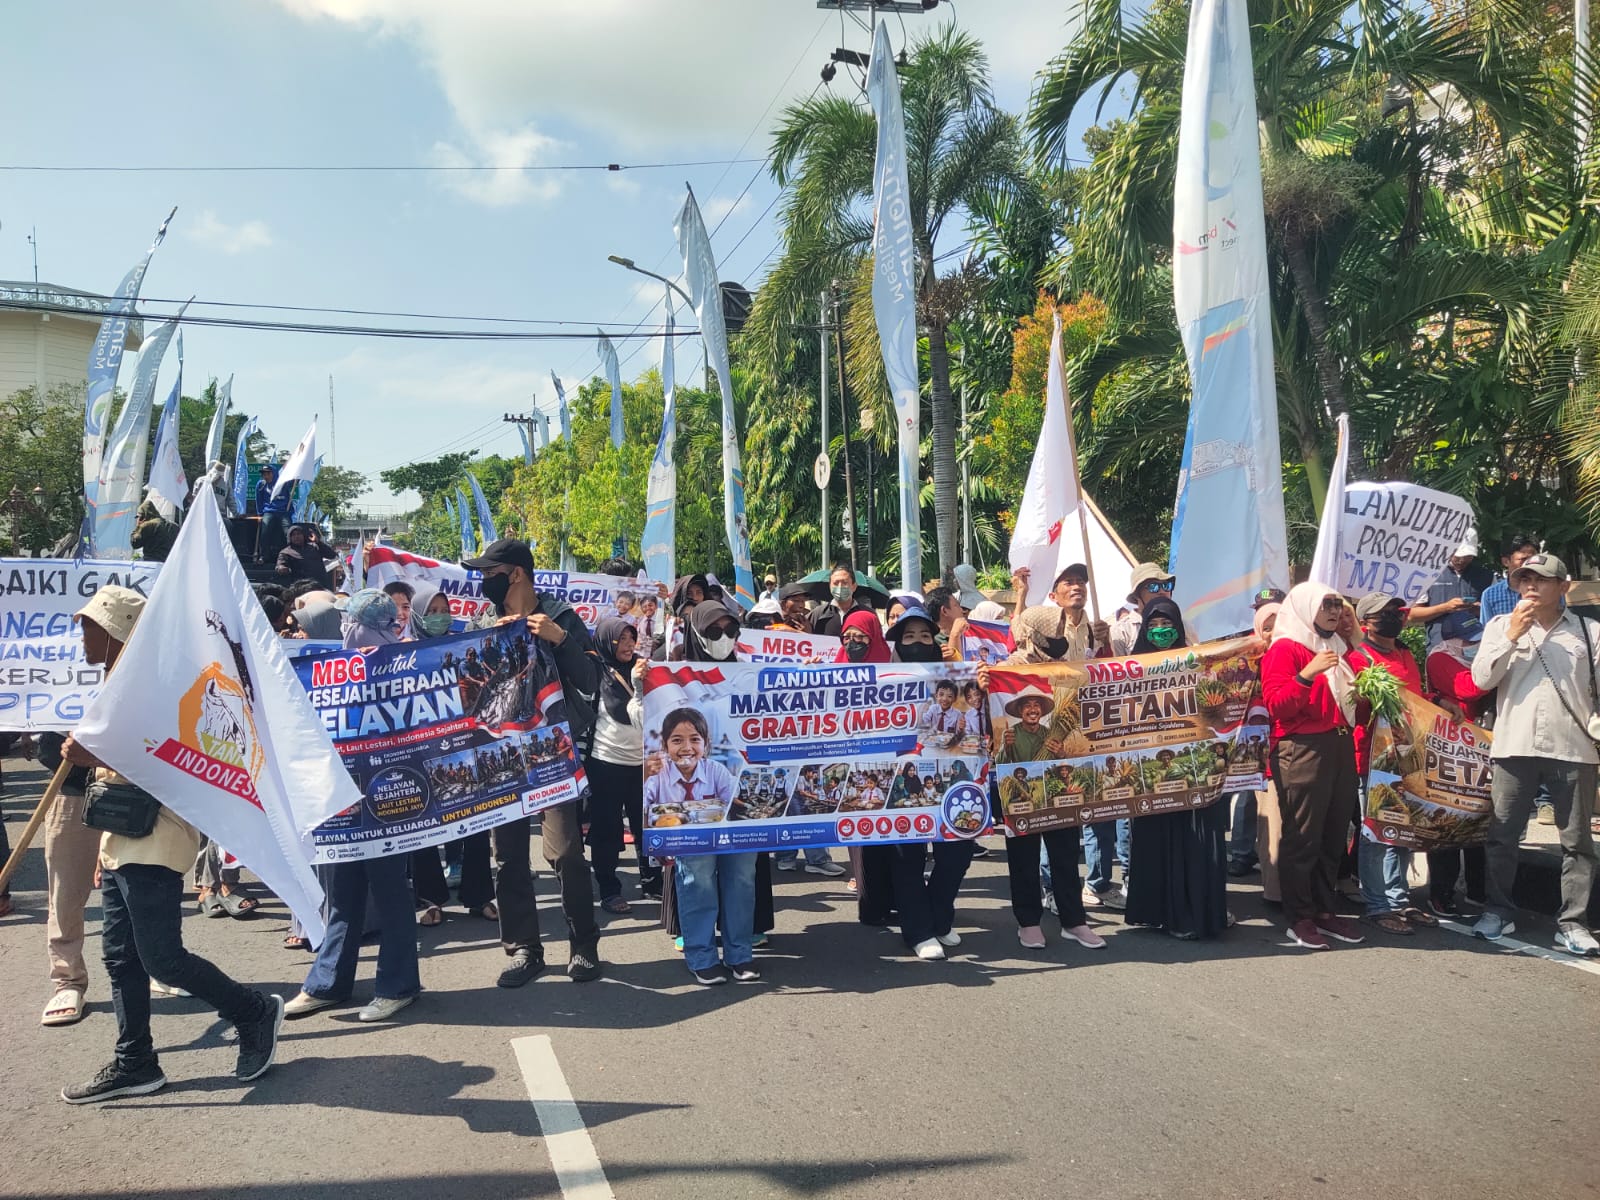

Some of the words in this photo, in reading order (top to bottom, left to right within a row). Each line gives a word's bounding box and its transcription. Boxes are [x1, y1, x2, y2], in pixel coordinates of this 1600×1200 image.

[0, 569, 67, 595] AIKI
[763, 637, 813, 657] MBG
[312, 656, 366, 687] MBG
[372, 650, 418, 676] untuk
[764, 669, 870, 689] LANJUTKAN
[1087, 660, 1144, 684] MBG
[1148, 656, 1187, 675] untuk
[730, 690, 825, 715] MAKAN
[835, 681, 925, 708] BERGIZI
[1078, 673, 1197, 700] KESEJAHTERAAN
[741, 713, 838, 740] GRATIS
[843, 704, 917, 734] (MBG)
[1082, 688, 1197, 729] PETANI
[397, 730, 435, 744] Indonesia
[1434, 714, 1475, 747] MBG
[173, 747, 259, 802] INDONES
[377, 779, 415, 793] NELAYAN
[373, 786, 422, 802] SEJAHTERA
[351, 829, 383, 840] UNTUK
[386, 817, 441, 834] KELUARGA,
[442, 808, 472, 822] UNTUK
